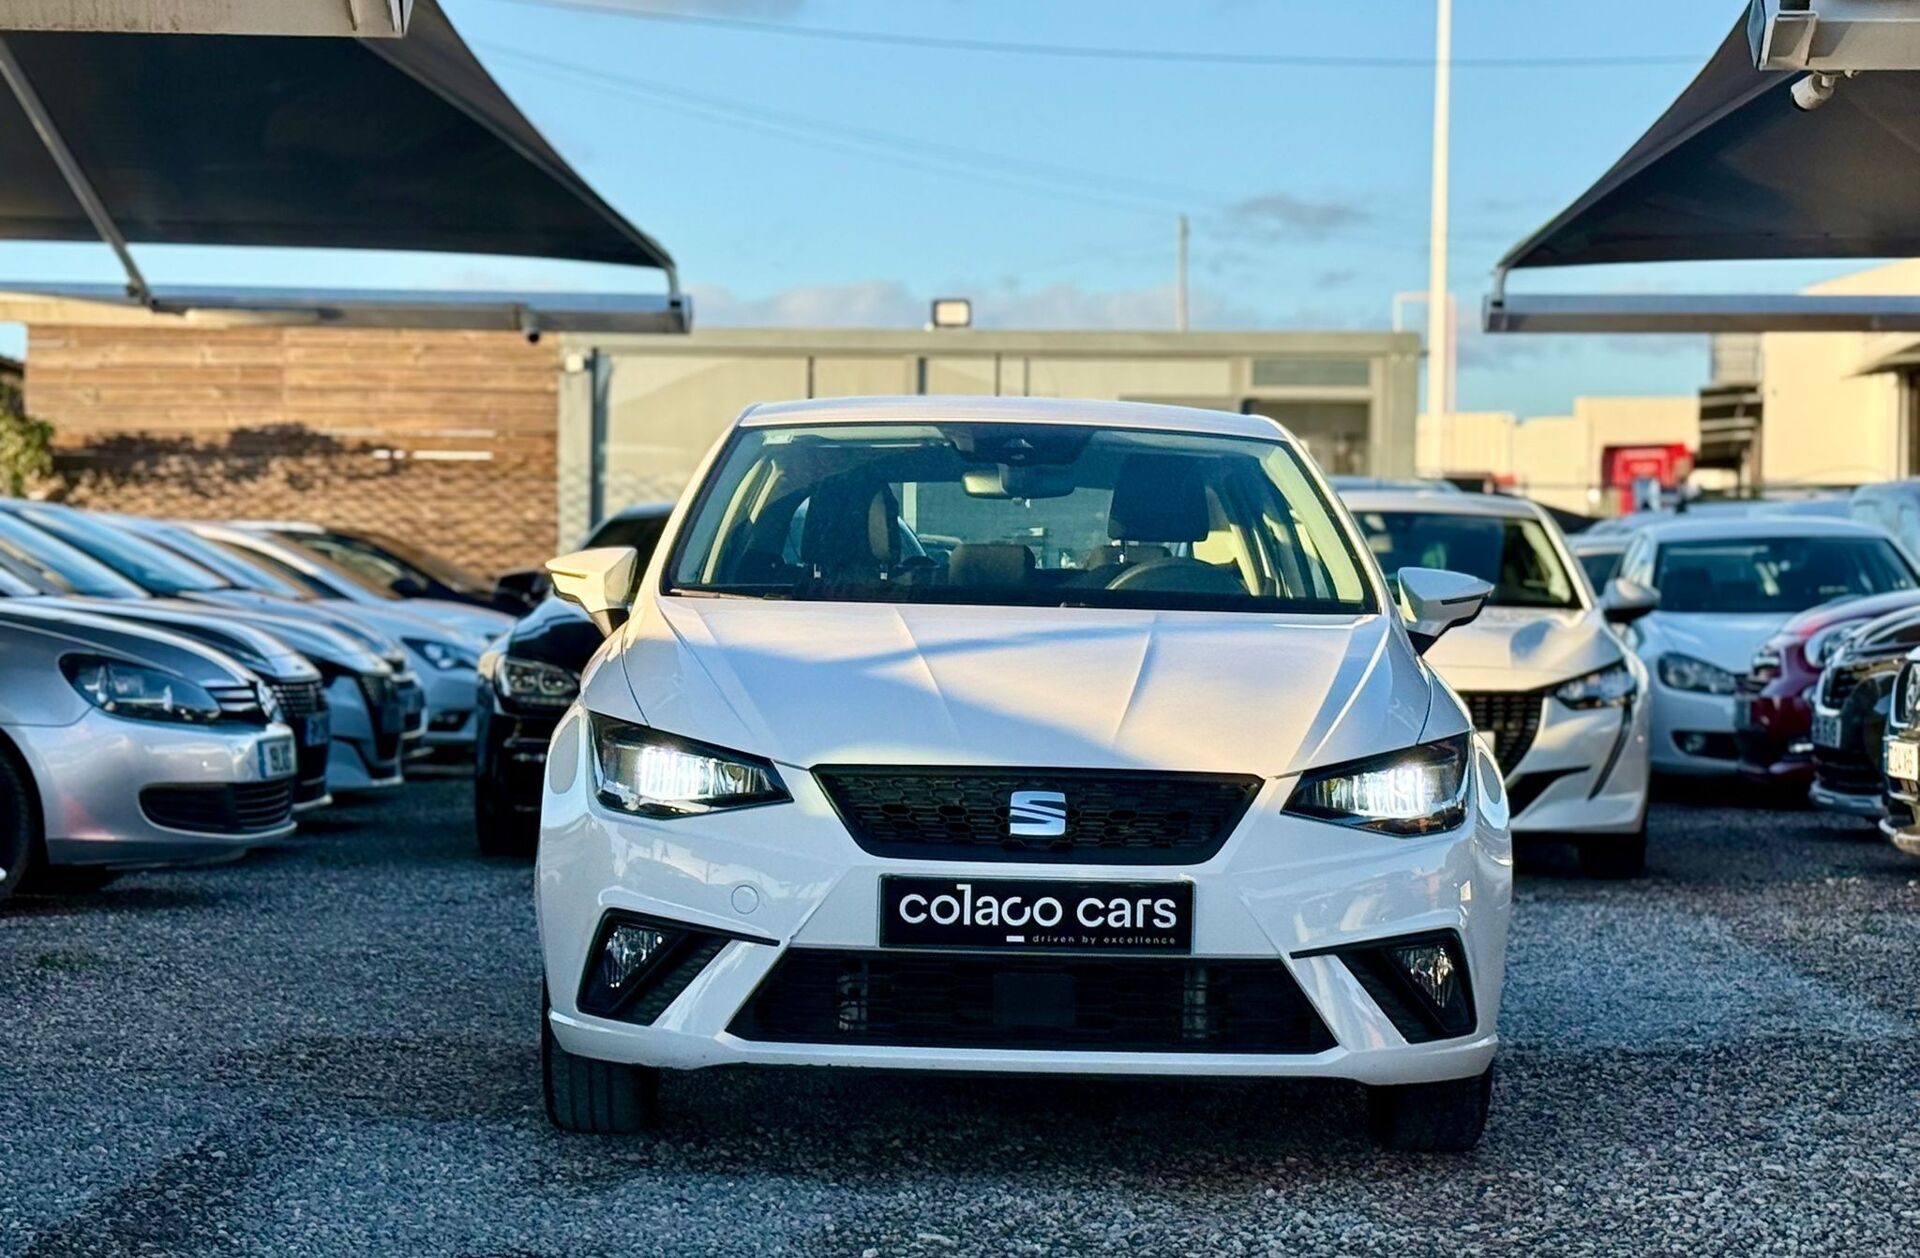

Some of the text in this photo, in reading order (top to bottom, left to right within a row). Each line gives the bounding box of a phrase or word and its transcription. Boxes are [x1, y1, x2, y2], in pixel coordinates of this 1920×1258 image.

[1076, 897, 1177, 929] cars
[1032, 934, 1176, 945] driven by excellence
